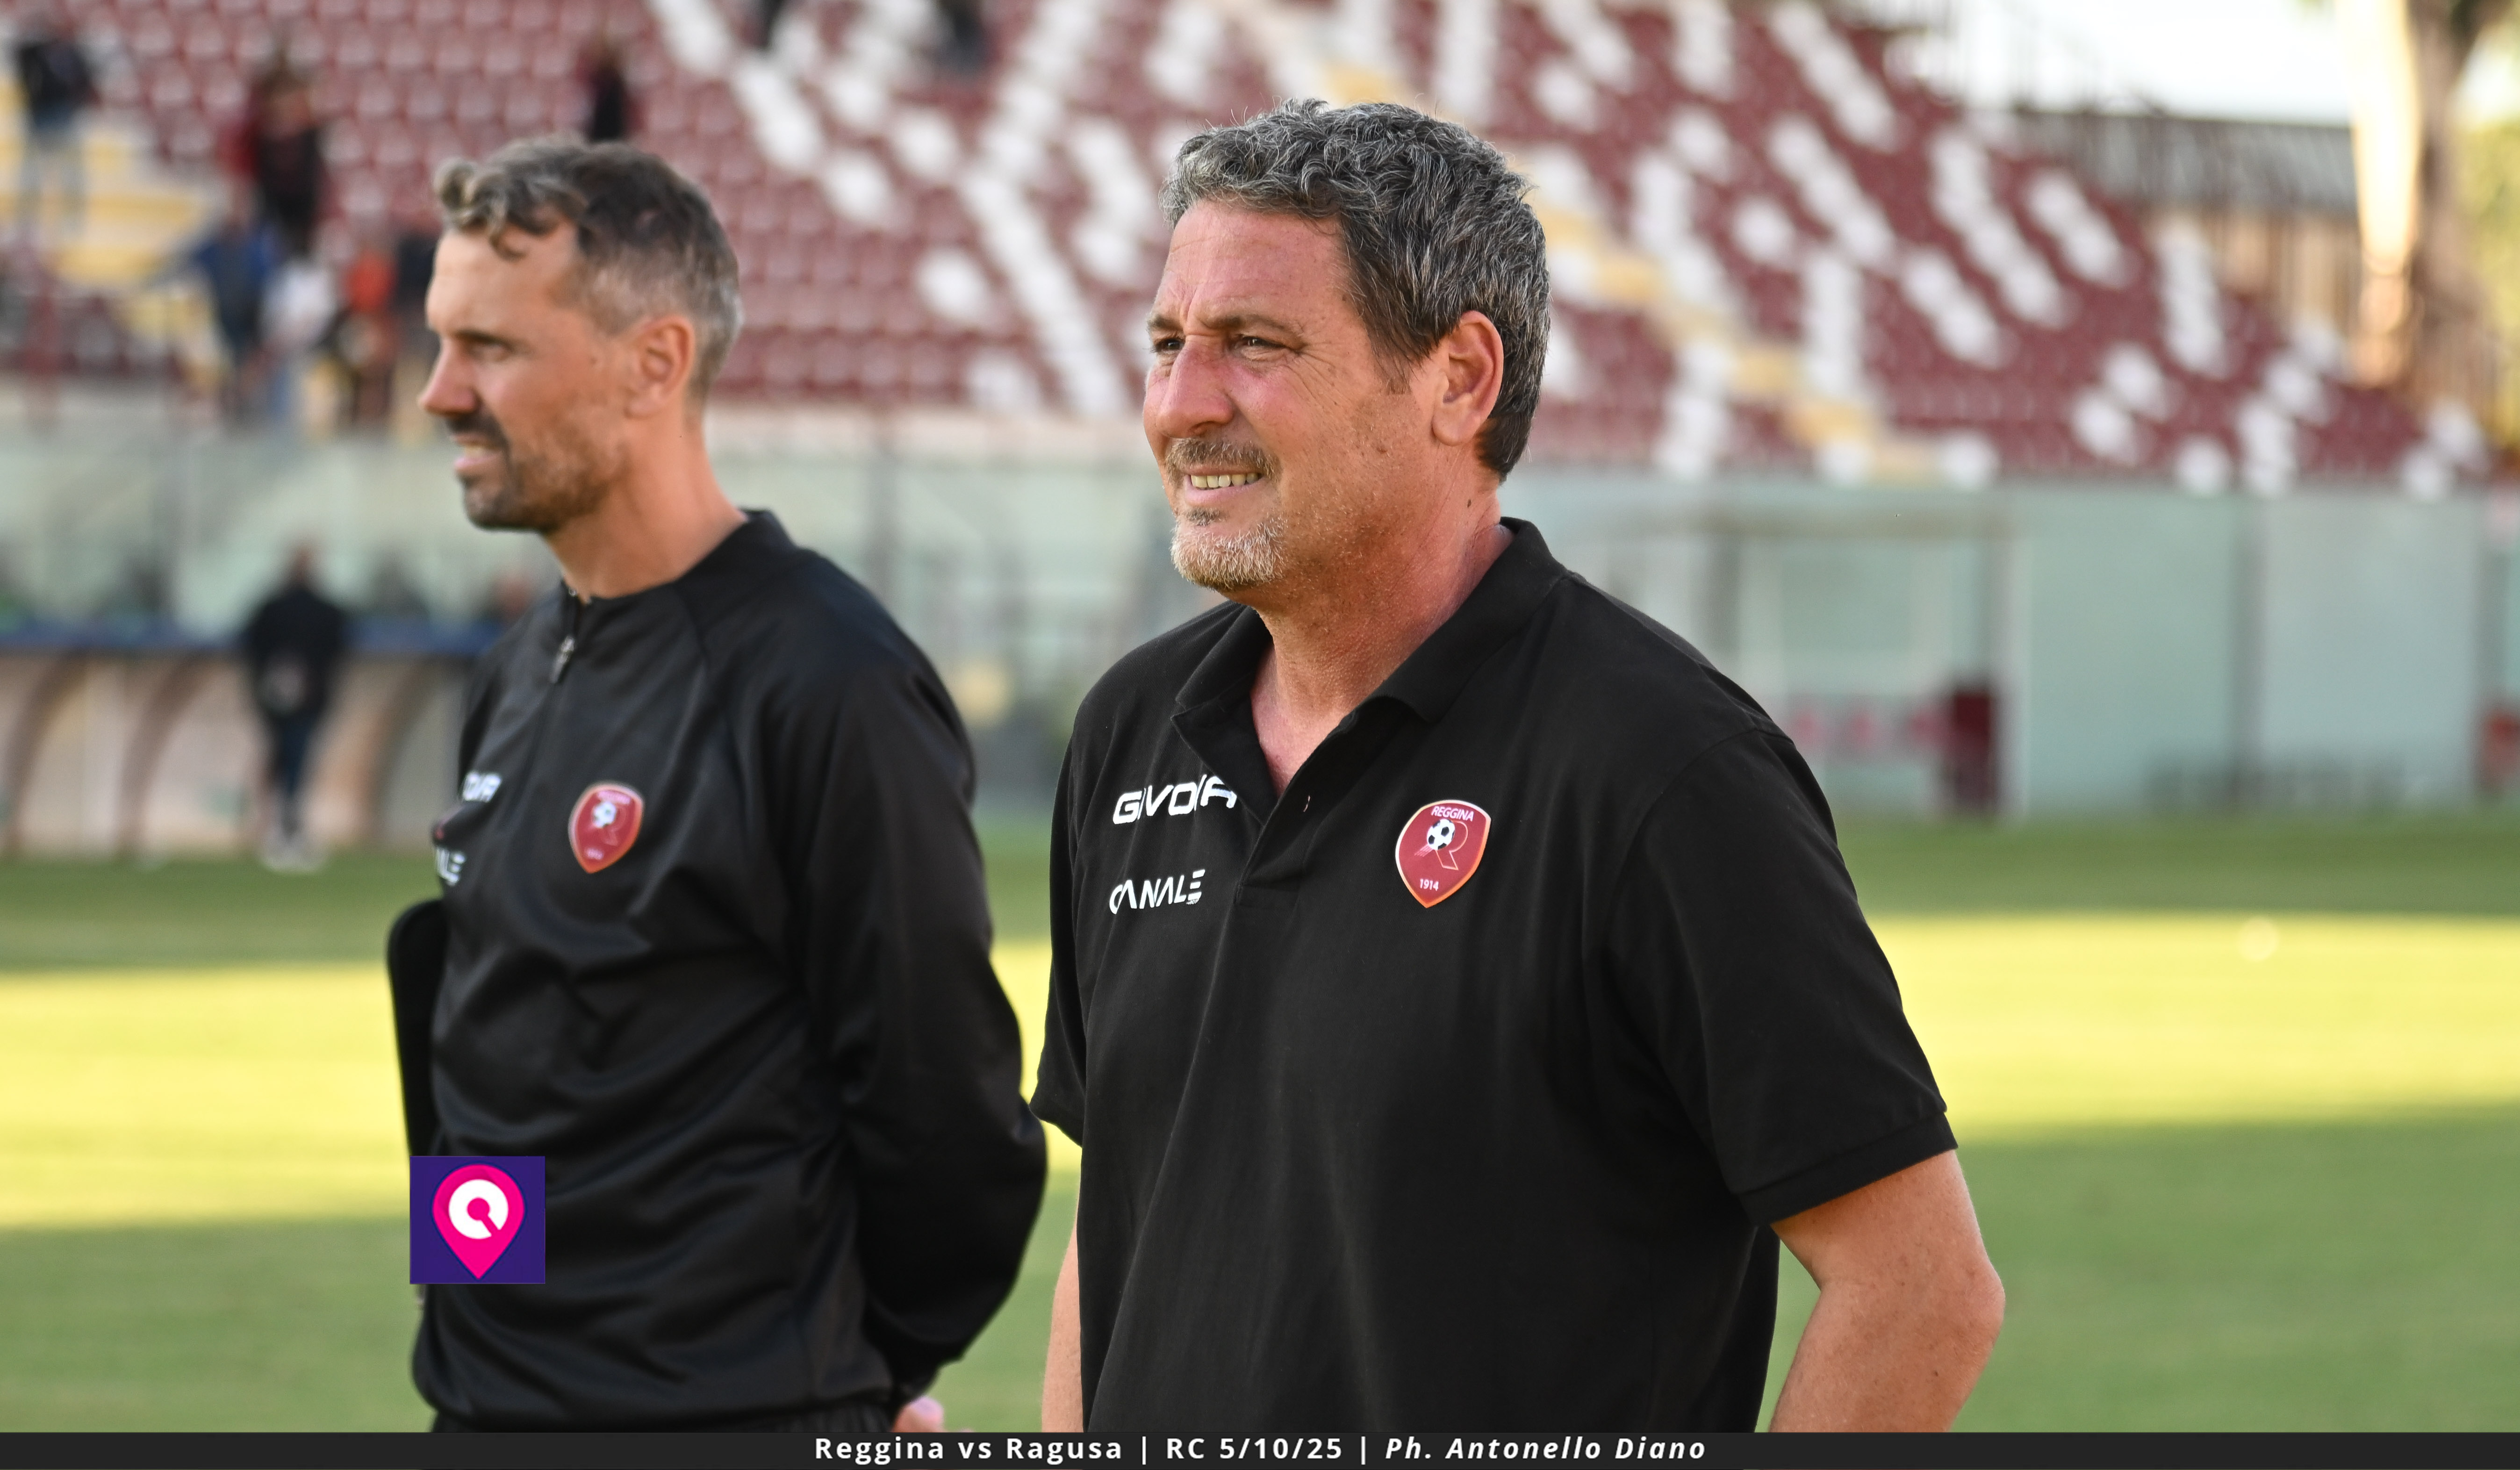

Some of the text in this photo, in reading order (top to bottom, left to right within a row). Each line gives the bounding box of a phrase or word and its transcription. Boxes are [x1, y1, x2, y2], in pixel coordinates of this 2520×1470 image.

[1431, 805, 1474, 822] REGGINA
[1109, 869, 1206, 915] CANALE
[1420, 878, 1439, 891] 1914
